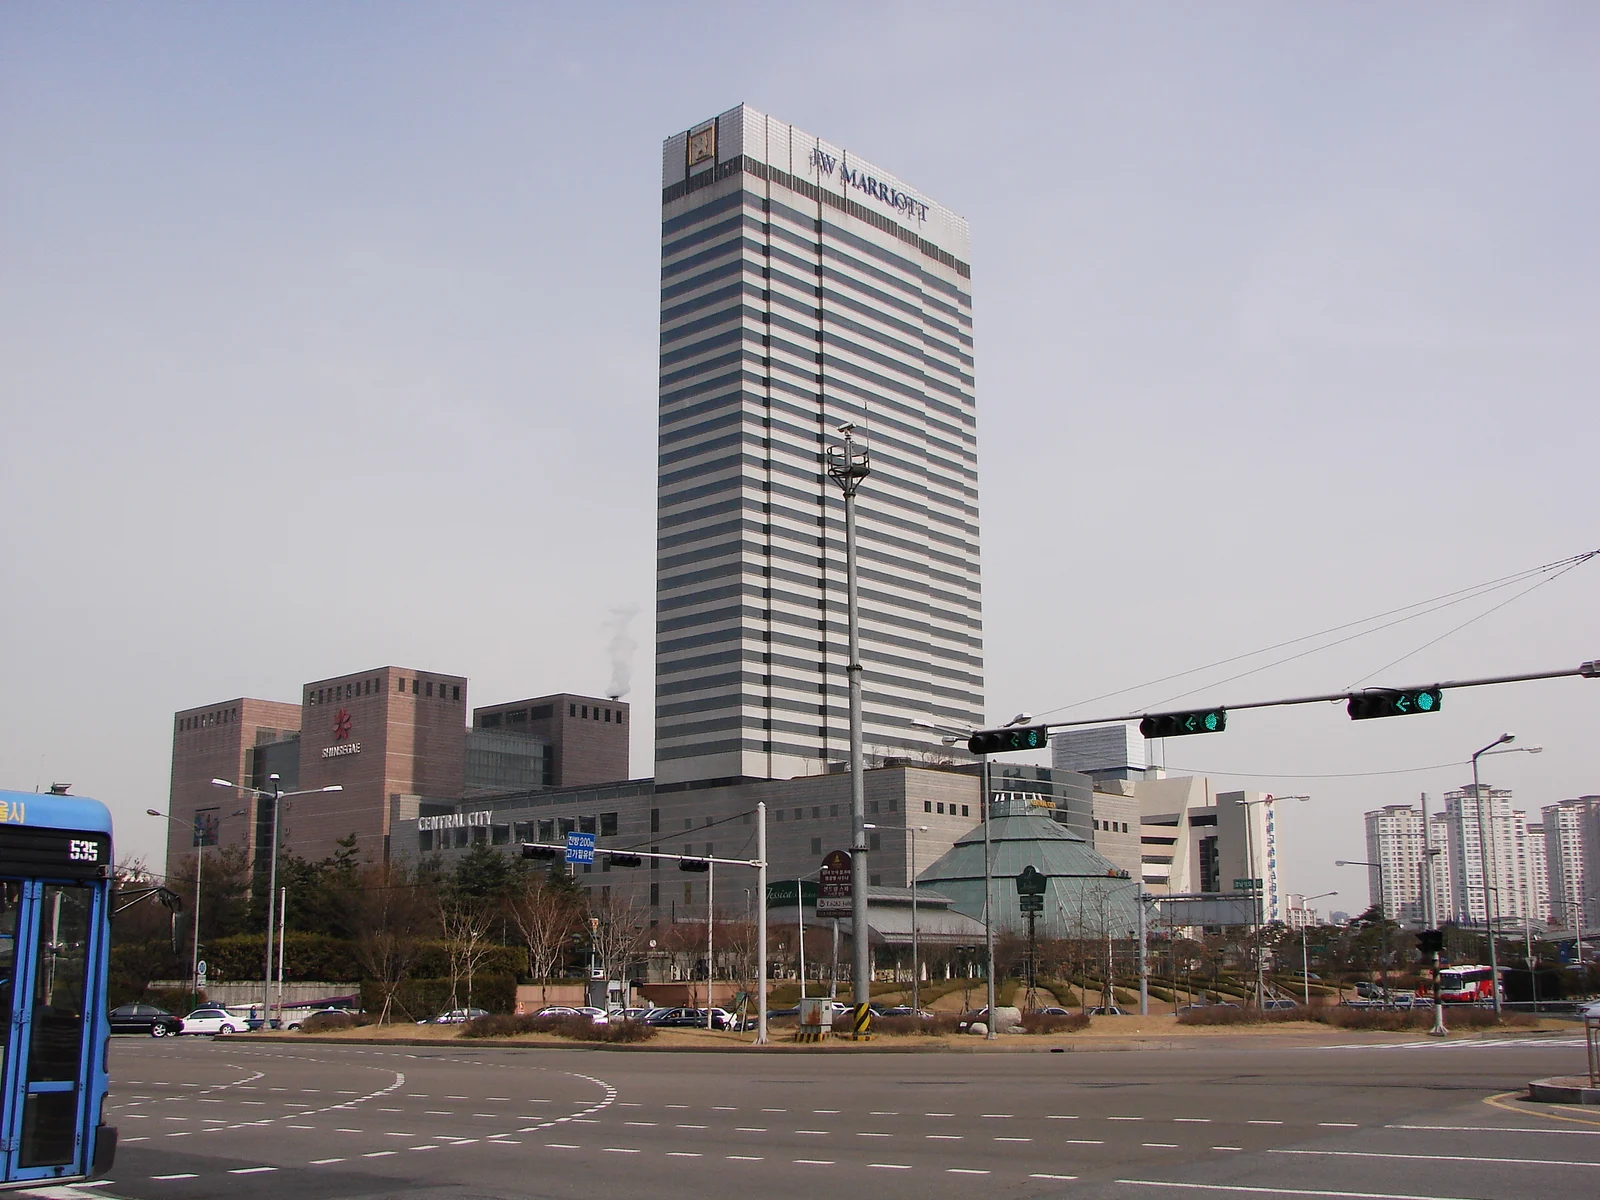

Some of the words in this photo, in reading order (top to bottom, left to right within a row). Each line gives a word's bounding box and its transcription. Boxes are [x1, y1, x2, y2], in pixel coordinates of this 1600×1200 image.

[810, 148, 837, 176] JW
[841, 162, 929, 222] MARRIOTT
[321, 742, 361, 758] SHINSEGAE
[418, 813, 465, 831] CENTRAL
[468, 810, 493, 826] CITY
[70, 840, 98, 861] 535
